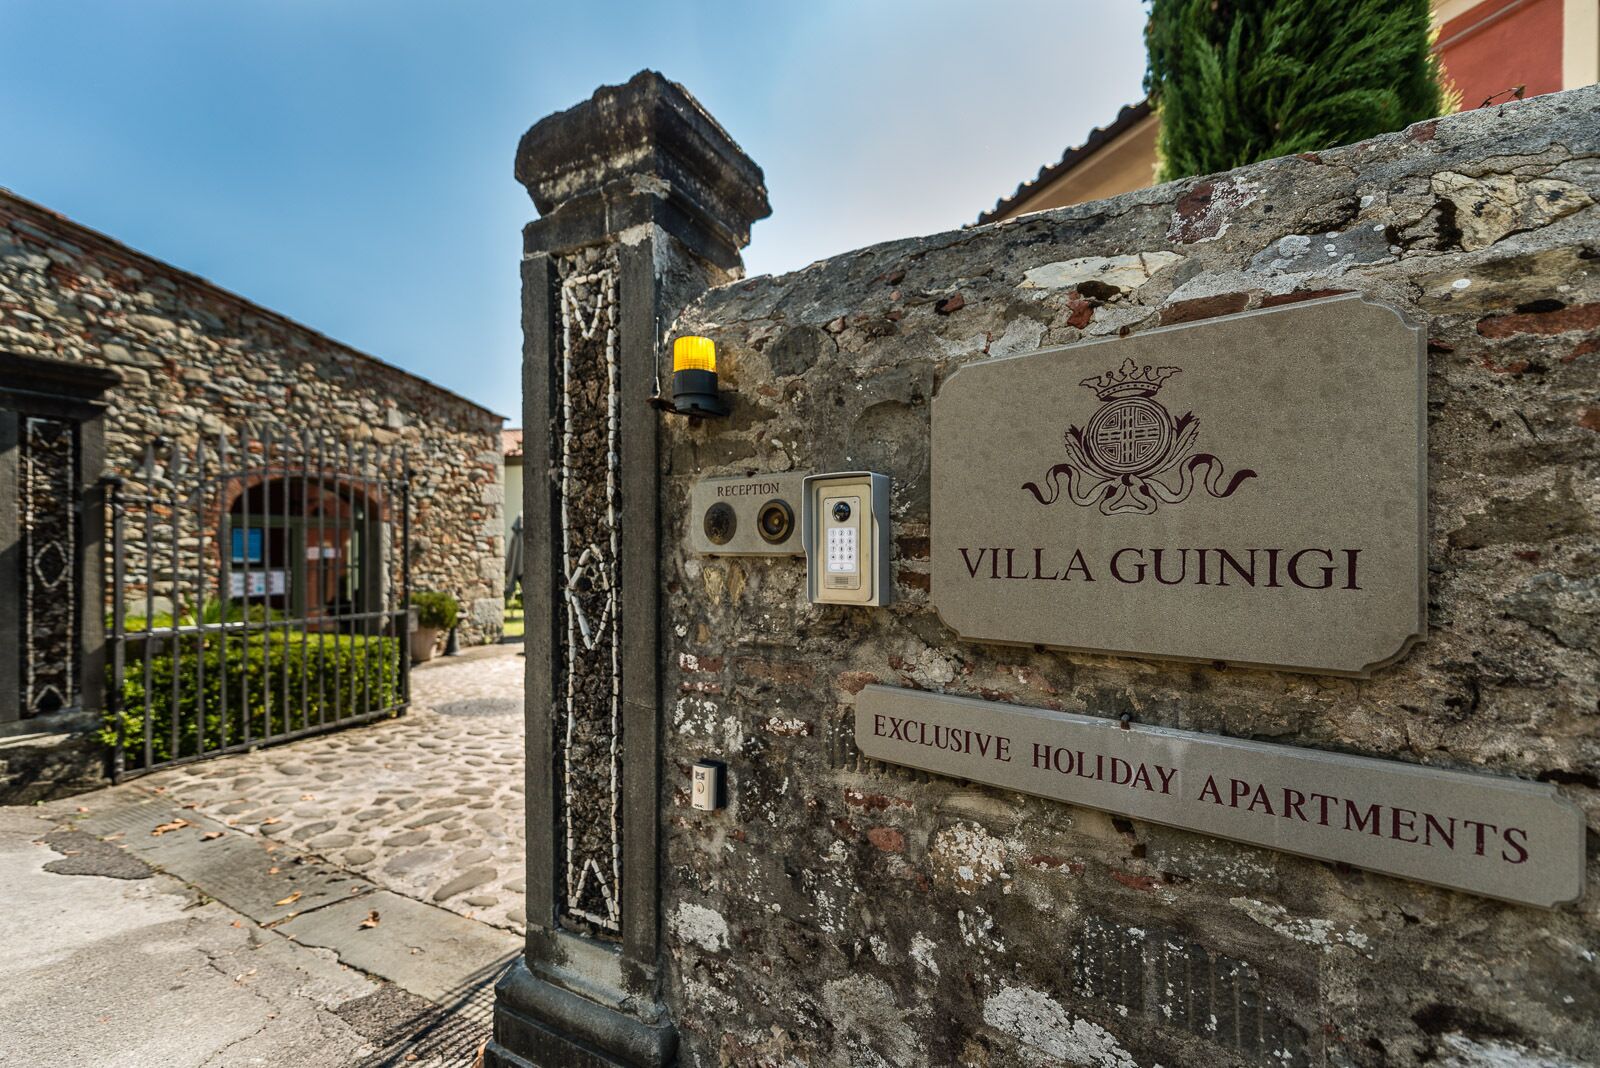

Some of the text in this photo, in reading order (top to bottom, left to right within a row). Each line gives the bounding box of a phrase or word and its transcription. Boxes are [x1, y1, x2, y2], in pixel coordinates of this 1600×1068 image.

[717, 482, 780, 497] RECEPTION
[959, 548, 1363, 590] VILLA GUINIGI
[873, 714, 1530, 864] EXCLUSIVE HOLIDAY APARTMENTS
